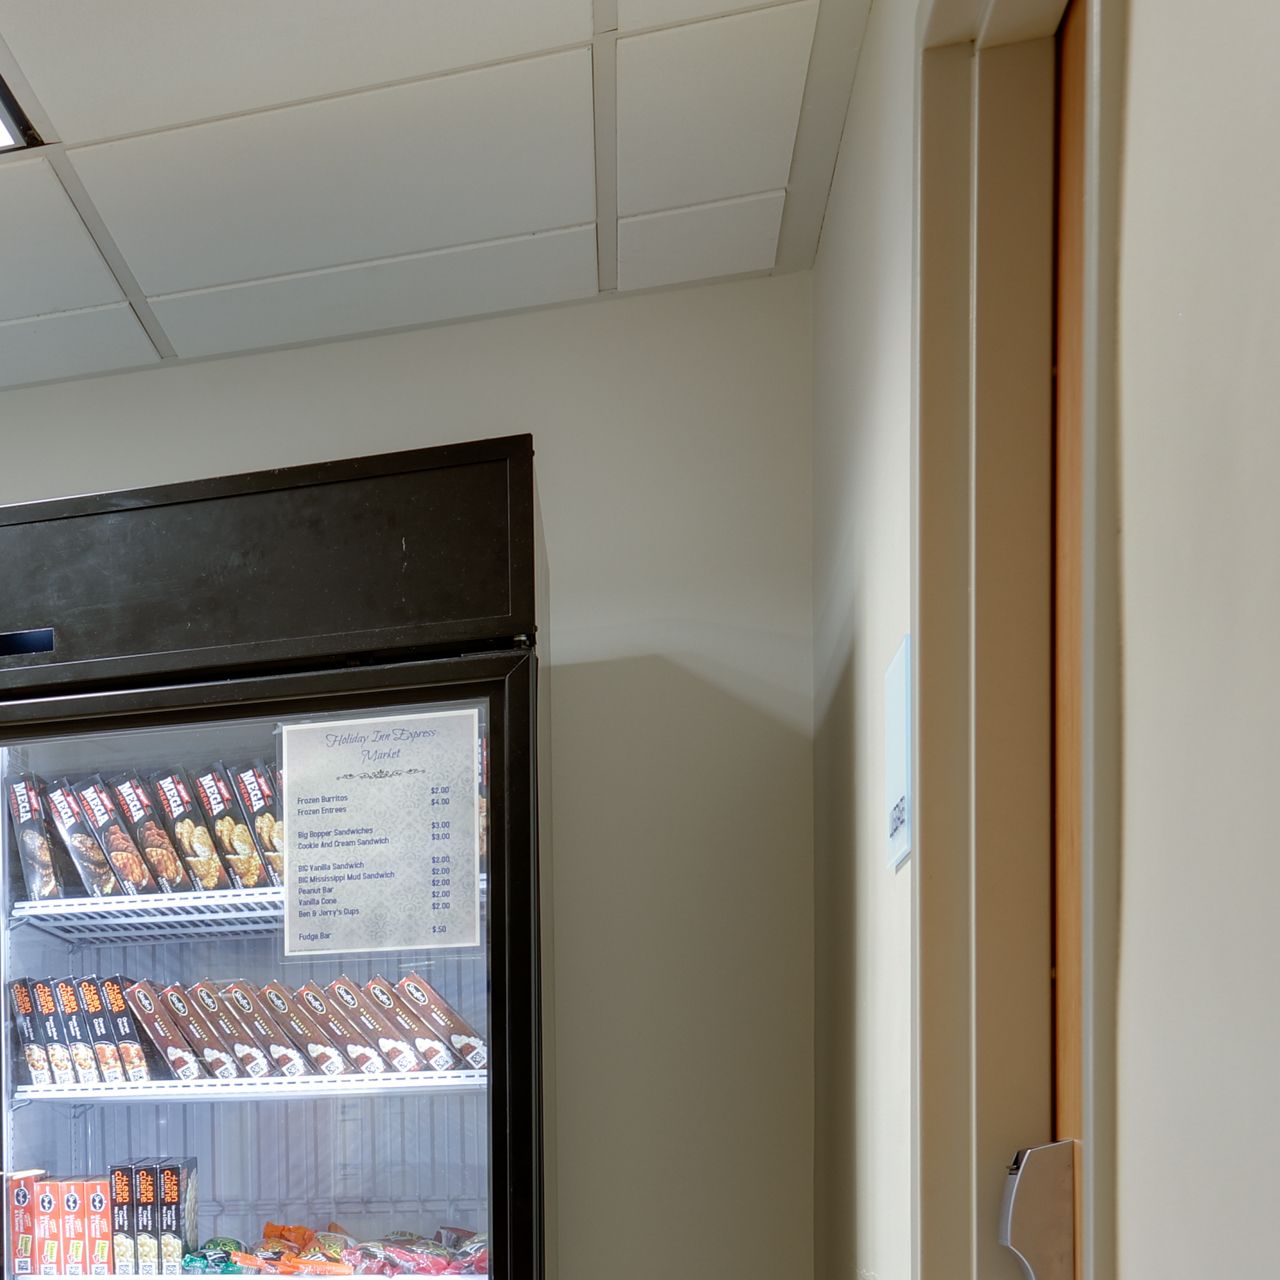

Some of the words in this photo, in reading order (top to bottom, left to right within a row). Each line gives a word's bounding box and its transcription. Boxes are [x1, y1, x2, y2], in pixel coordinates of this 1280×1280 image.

[326, 733, 369, 747] Holiday
[371, 731, 390, 742] Inn
[392, 728, 436, 741] Express
[361, 748, 401, 763] Market
[199, 773, 224, 816] MEGA
[240, 769, 264, 812] MEGA
[431, 786, 449, 794] $2.00
[12, 781, 31, 823] MEGA
[117, 780, 145, 823] MEGA
[159, 776, 185, 818] MEGA
[297, 797, 320, 805] Frozen
[321, 795, 348, 803] Burritos
[431, 798, 449, 806] $4.00
[48, 789, 76, 829] MEGA
[80, 785, 110, 827] MEGA
[321, 806, 347, 814] Entrees
[431, 821, 450, 829] $3.00
[309, 830, 331, 838] Bopper
[334, 827, 373, 836] Sandwiches
[431, 833, 450, 841] $3.00
[298, 842, 319, 850] Cookie
[357, 838, 389, 846] Sandwich
[432, 856, 450, 864] $2.00
[332, 862, 364, 870] Sandwich
[432, 867, 450, 875] $2.00
[310, 873, 345, 883] Mississippi
[363, 871, 395, 879] Sandwich
[432, 879, 450, 887] $2.00
[432, 902, 450, 910] $2.00
[299, 910, 311, 918] Ben
[319, 909, 342, 917] Jerry's
[344, 908, 359, 916] Cups
[299, 933, 319, 942] Fudge
[320, 932, 331, 940] Bar
